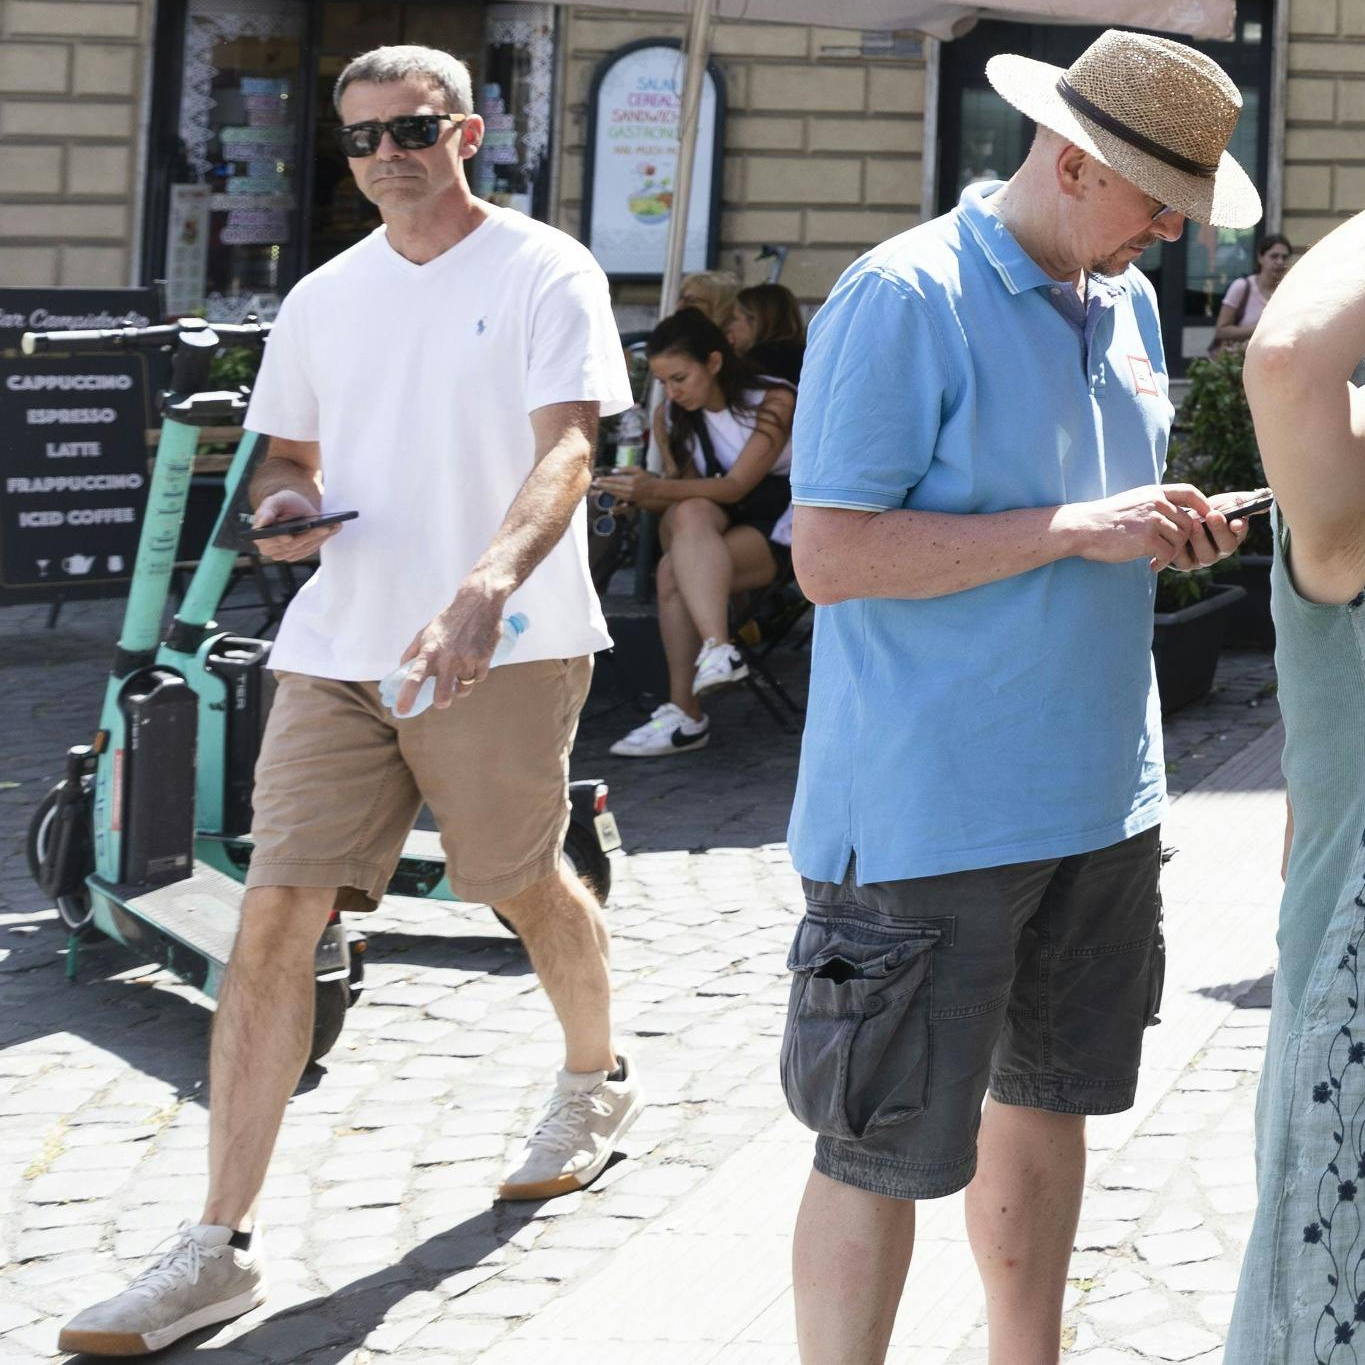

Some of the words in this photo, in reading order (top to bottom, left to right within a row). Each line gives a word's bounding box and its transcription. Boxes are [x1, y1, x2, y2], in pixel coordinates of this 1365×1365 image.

[6, 374, 133, 391] CAPPUCCINO
[27, 408, 117, 424] ESPRESSO
[46, 442, 102, 457] LATTE
[6, 474, 144, 493] FRAPPUCCINO
[19, 510, 64, 528] ICED
[67, 507, 136, 526] COFFEE
[236, 675, 247, 709] TIER
